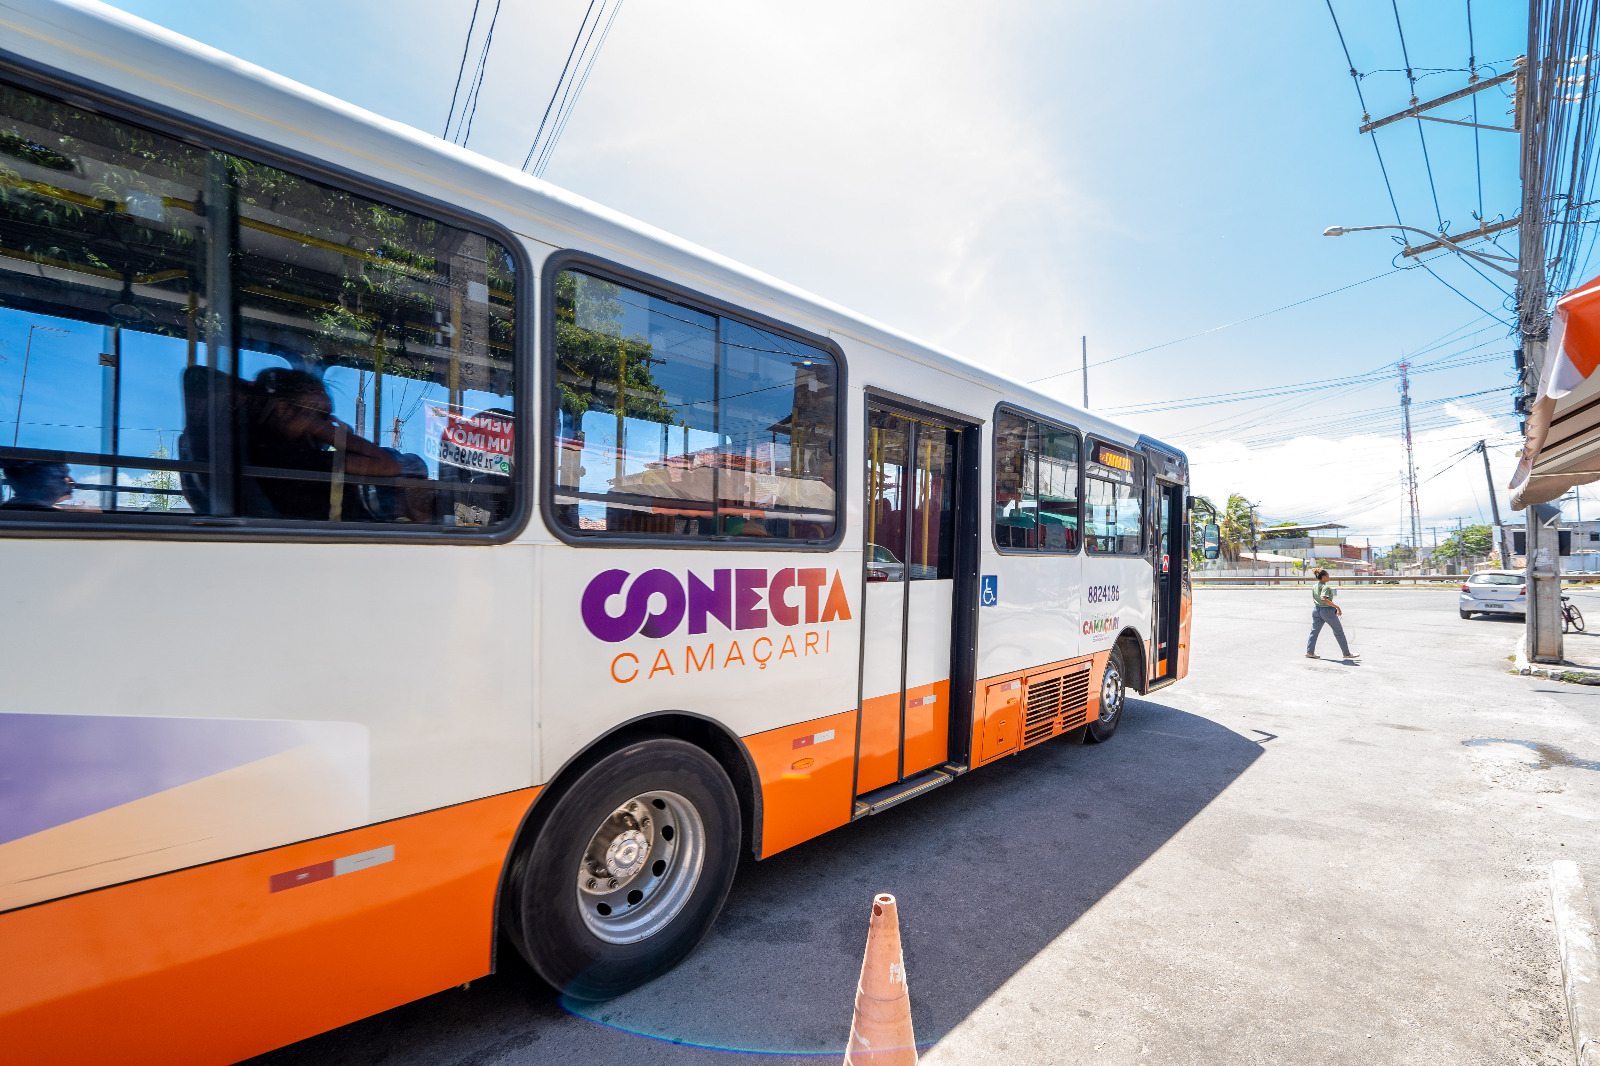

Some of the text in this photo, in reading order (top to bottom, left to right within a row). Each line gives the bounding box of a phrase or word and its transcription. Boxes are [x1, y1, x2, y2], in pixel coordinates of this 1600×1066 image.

[581, 568, 852, 643] CONECTA
[1088, 585, 1120, 603] 8824186
[611, 630, 830, 684] CAMAÇARI
